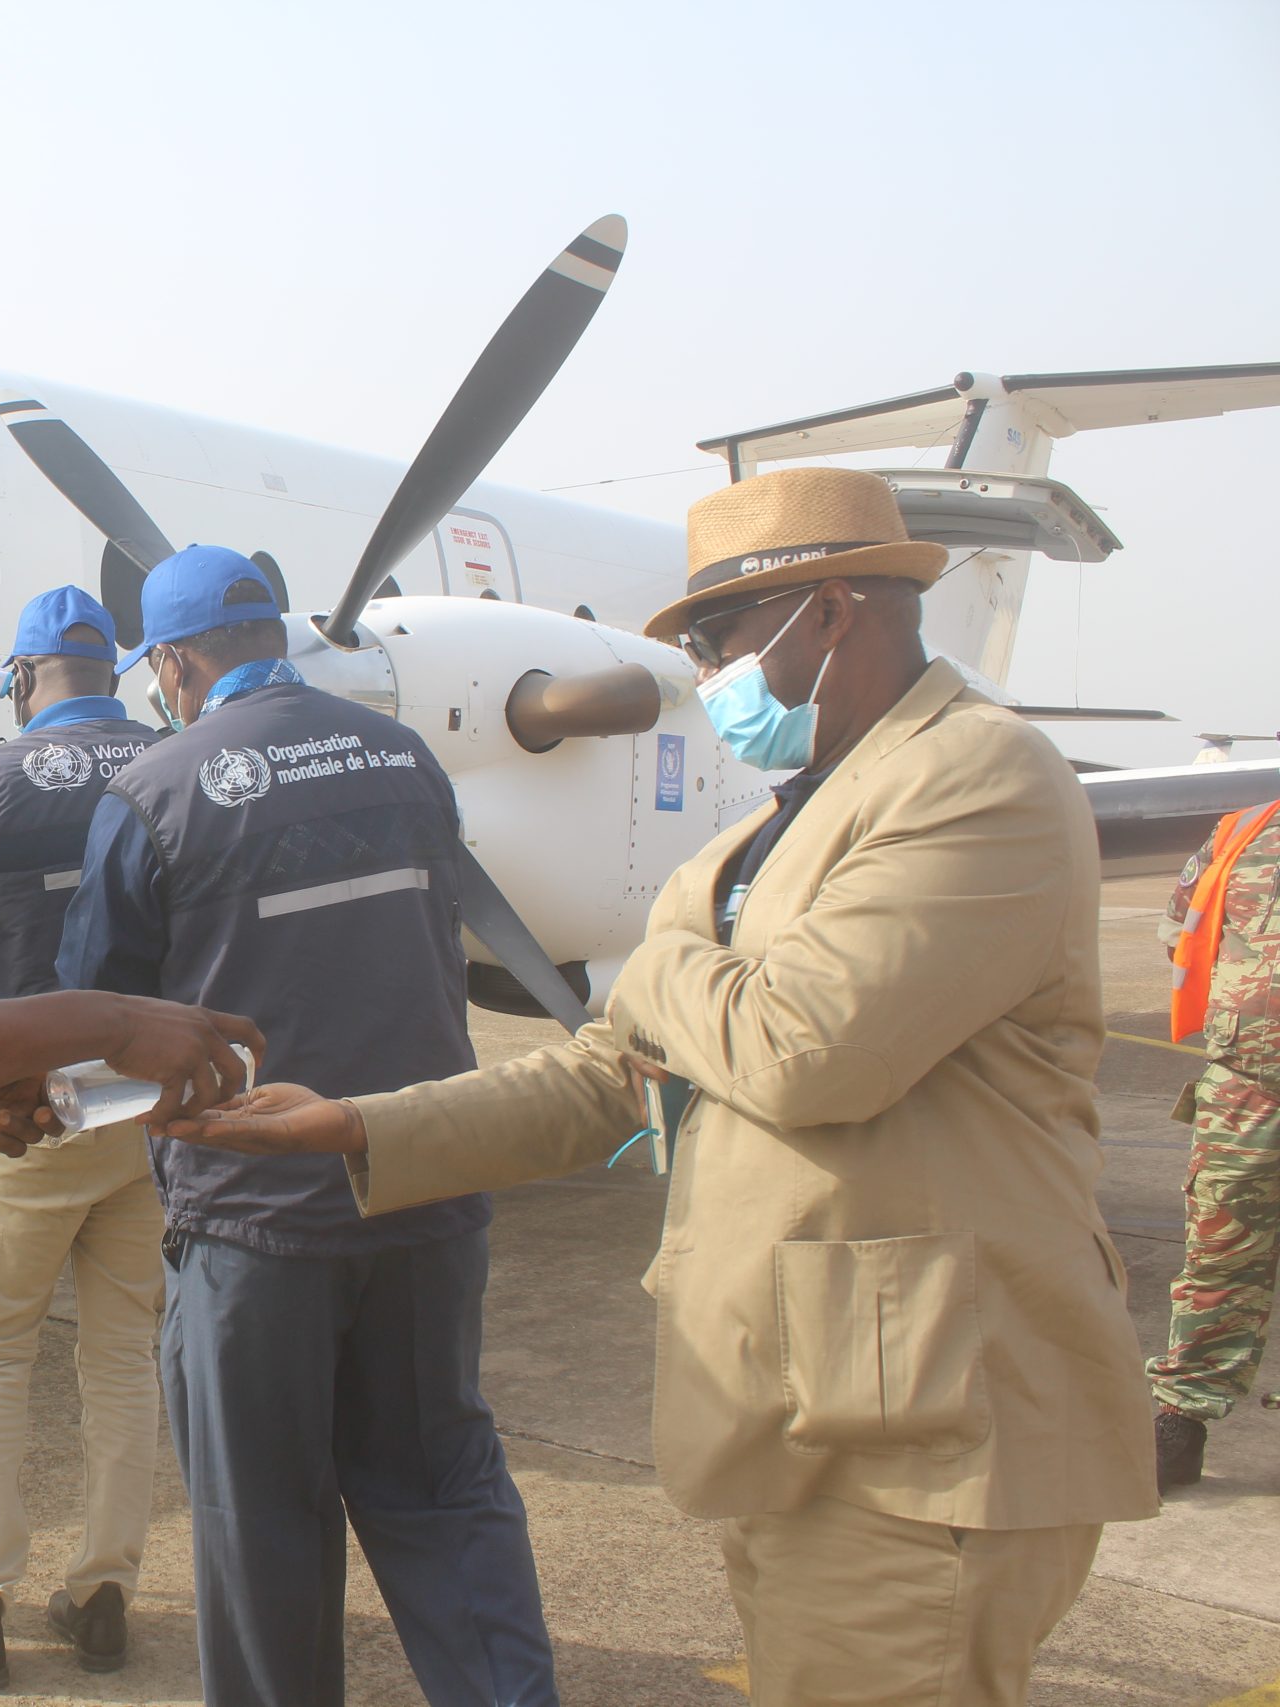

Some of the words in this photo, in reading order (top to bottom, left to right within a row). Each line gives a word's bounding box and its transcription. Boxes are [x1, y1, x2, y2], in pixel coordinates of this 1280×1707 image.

[450, 527, 477, 538] EMERGENCY
[92, 741, 145, 759] World
[267, 733, 363, 764] Organisation
[99, 762, 127, 779] Or
[276, 757, 345, 785] mondiale
[346, 752, 365, 771] de
[365, 750, 382, 768] la
[380, 750, 417, 768] Santé
